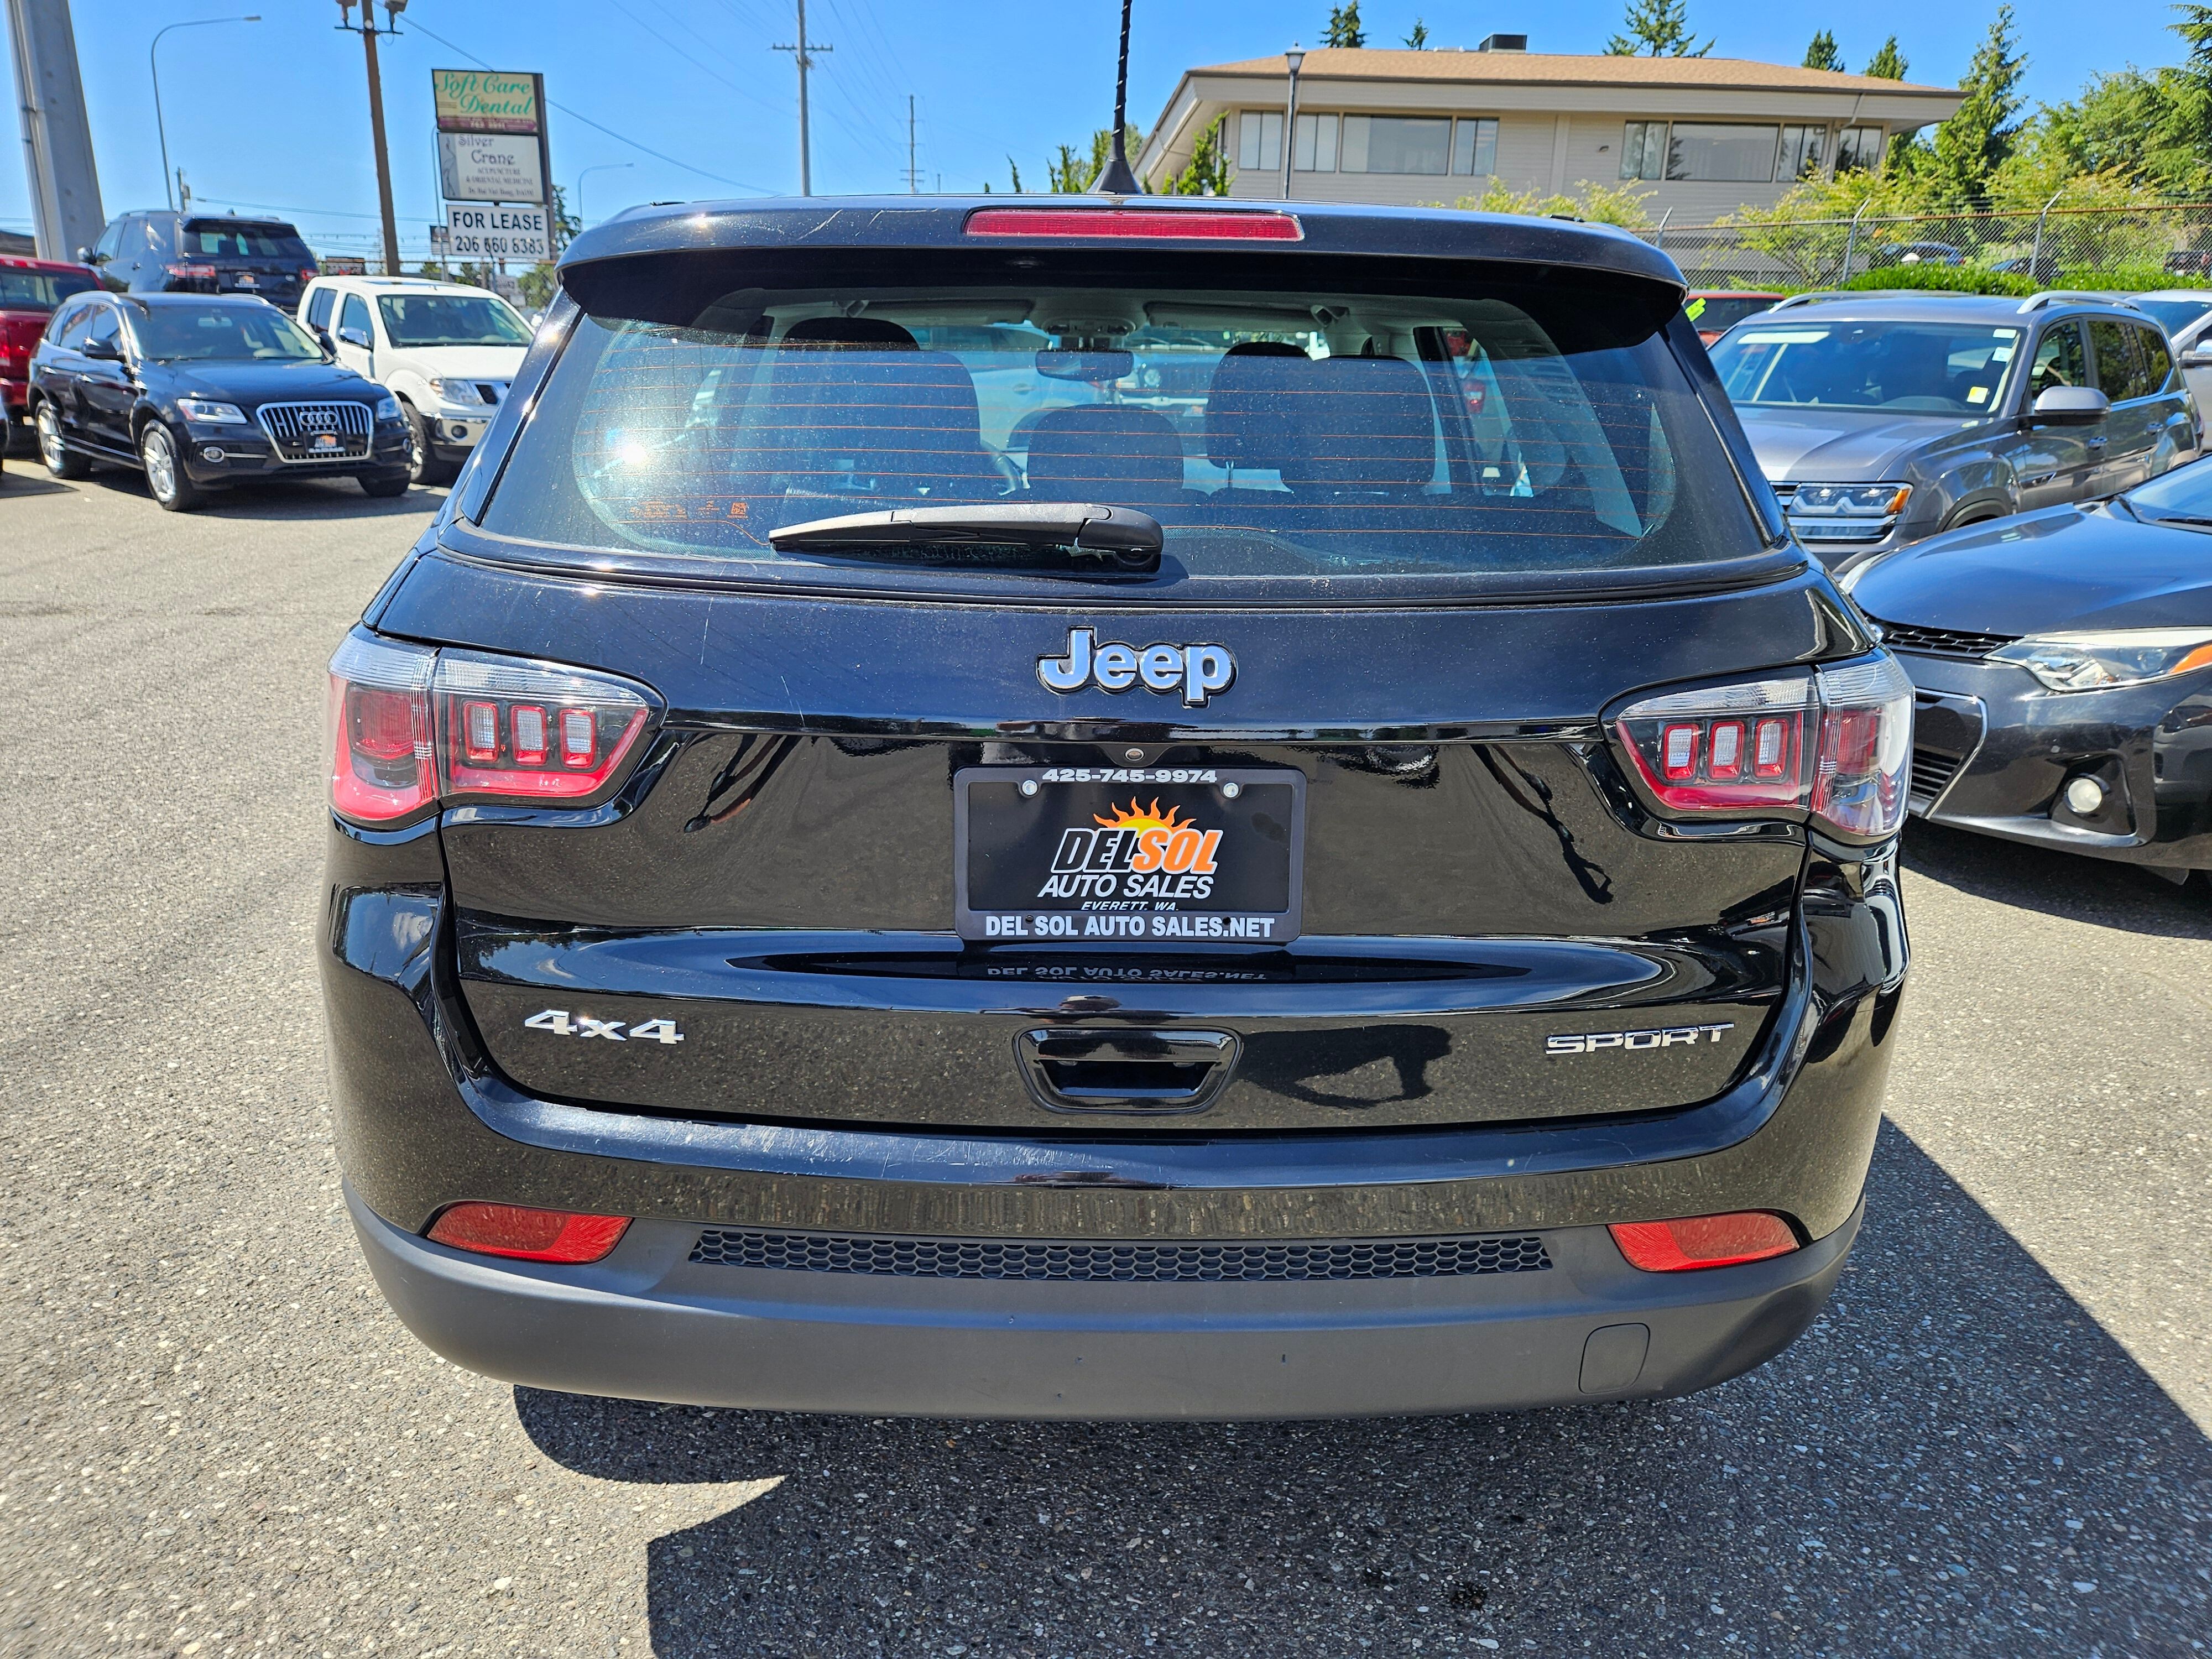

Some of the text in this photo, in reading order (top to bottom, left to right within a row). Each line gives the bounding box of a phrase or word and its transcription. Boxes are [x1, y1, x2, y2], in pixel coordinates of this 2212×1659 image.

[435, 71, 534, 100] Soft Care
[460, 93, 533, 114] Dental
[459, 134, 494, 147] Silver
[471, 149, 515, 165] Crane
[453, 212, 542, 231] FOR LEASE
[456, 236, 479, 252] 206
[513, 238, 544, 254] 8383
[1041, 629, 1233, 702] Jeep
[1042, 769, 1217, 783] 425-745-9974
[1037, 874, 1214, 899] AUTO SALES
[986, 915, 1275, 937] DEL SOL AUTO SALES.NET
[525, 1009, 685, 1045] 4x4
[1546, 1022, 1734, 1055] SPORT
